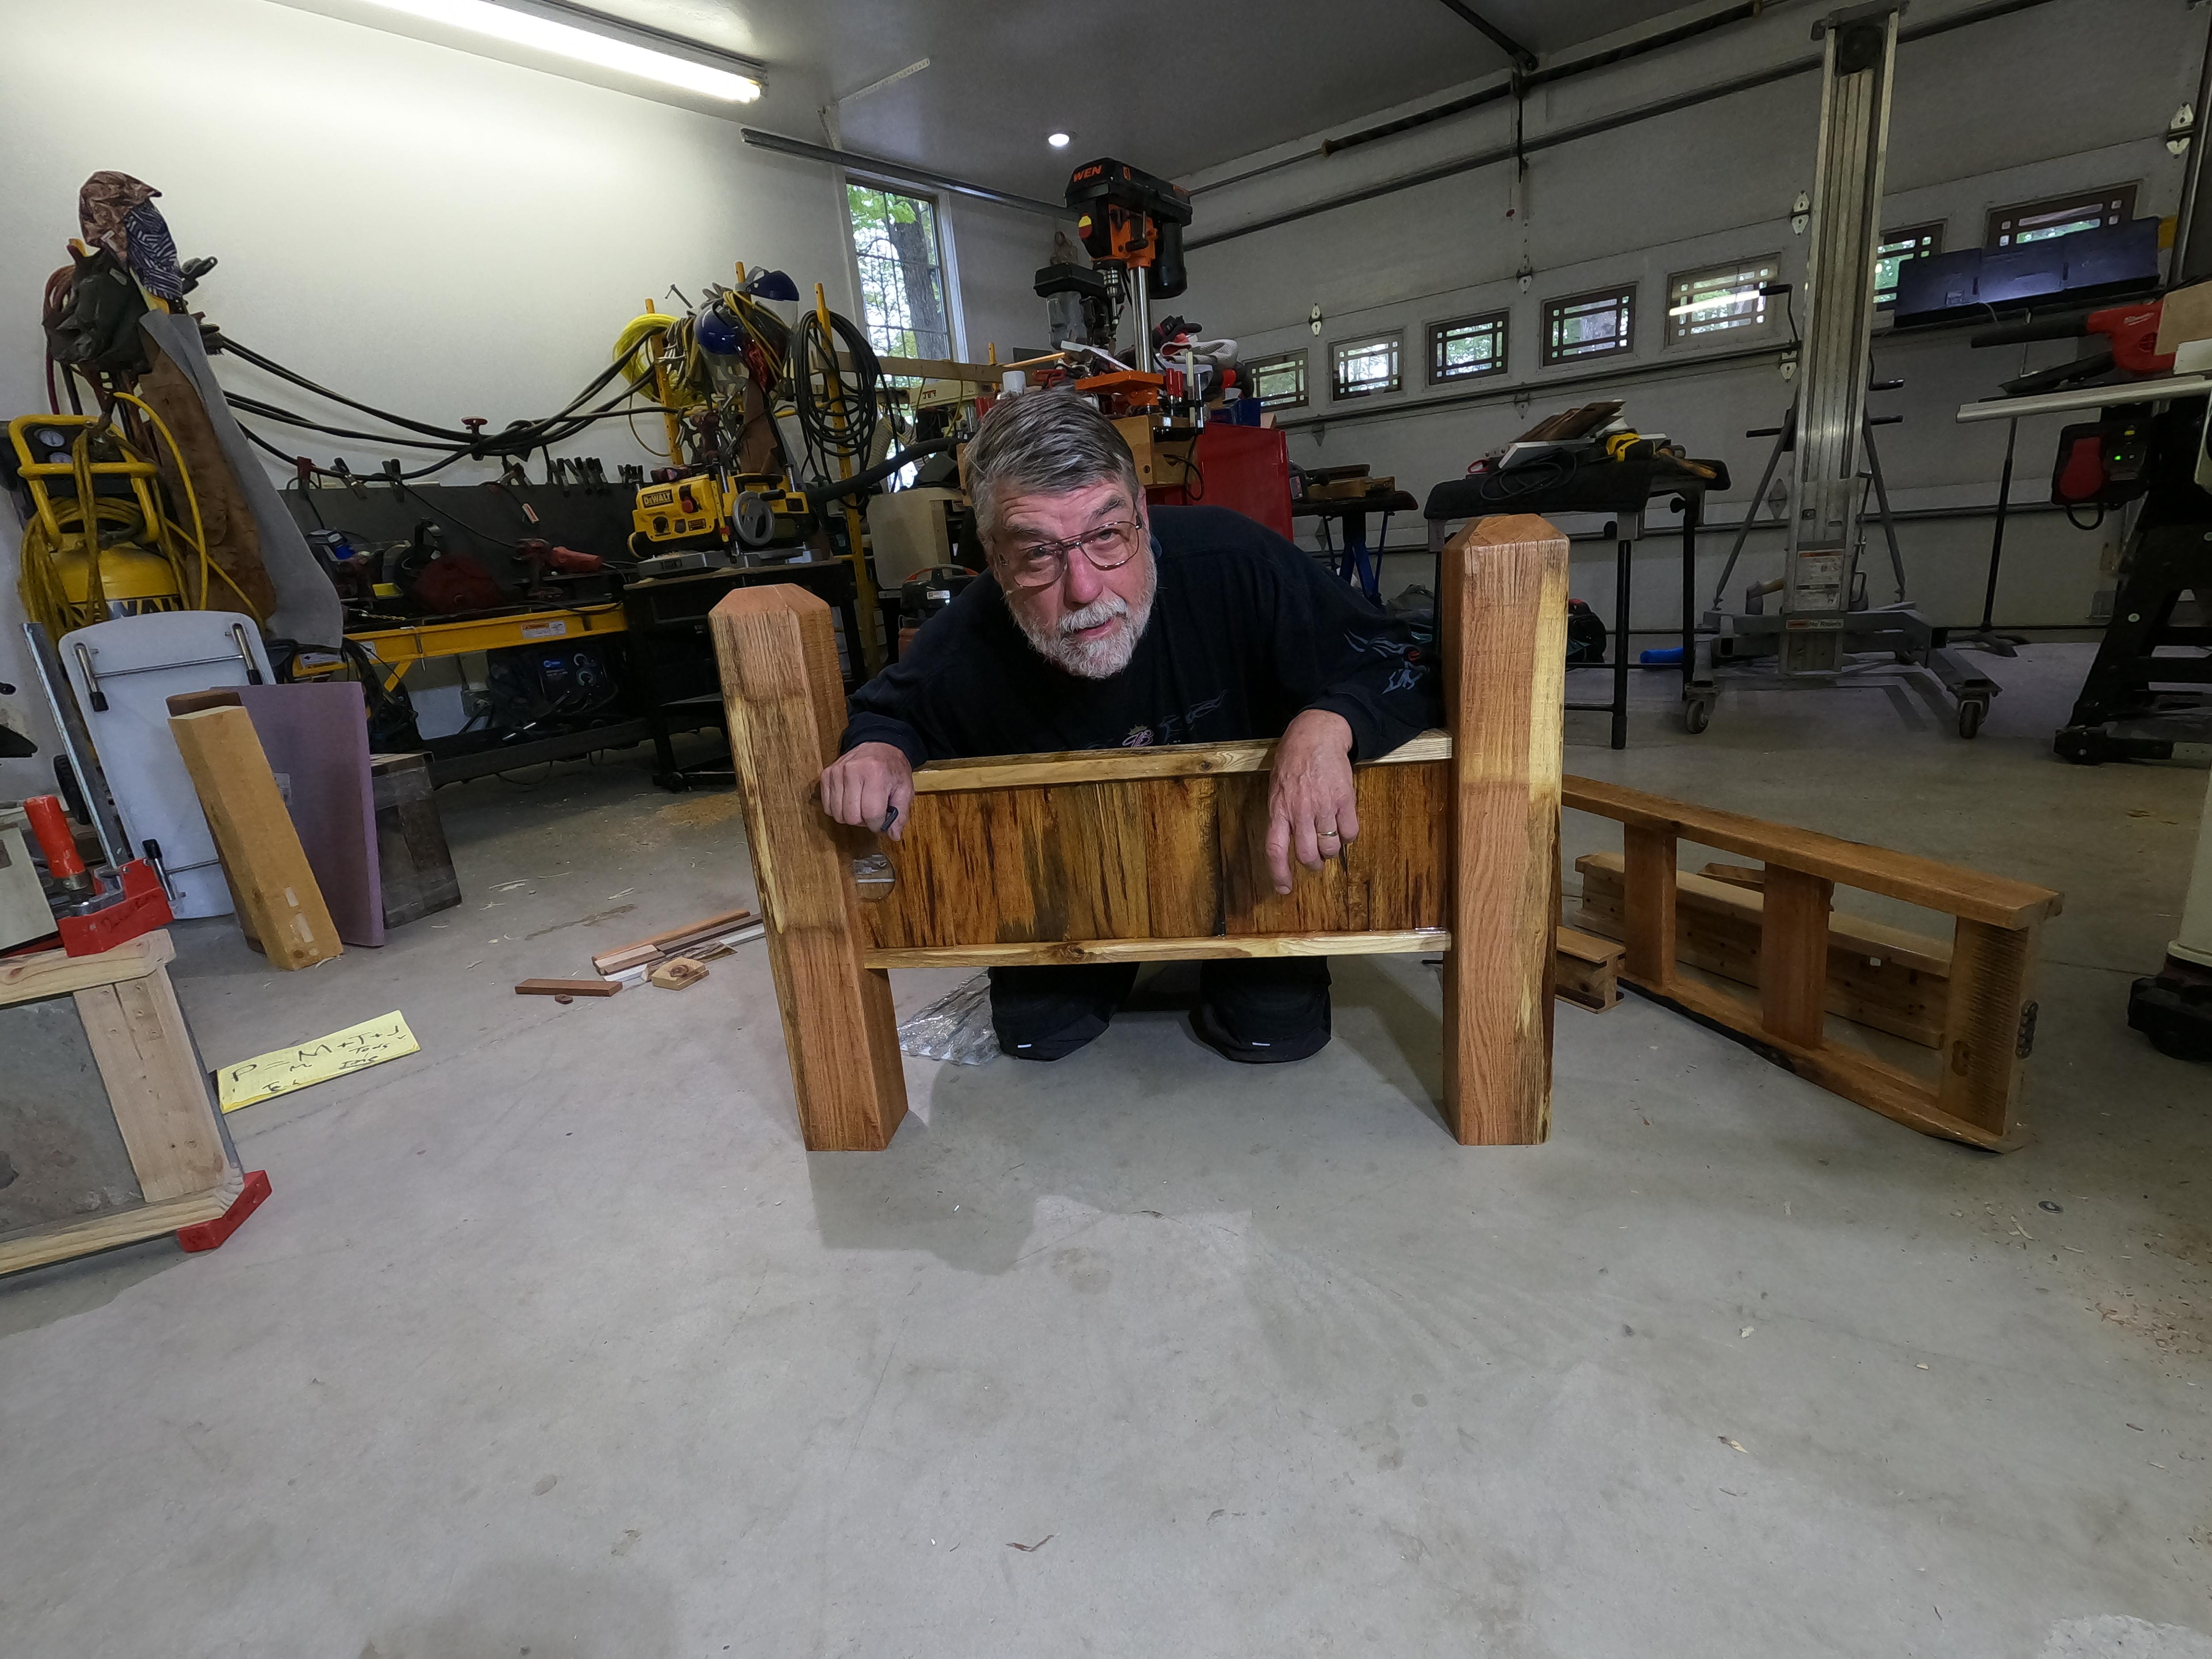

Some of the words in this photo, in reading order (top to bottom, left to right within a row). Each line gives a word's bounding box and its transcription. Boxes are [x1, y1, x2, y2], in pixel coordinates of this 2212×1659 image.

[1073, 164, 1102, 182] WEN
[922, 390, 937, 399] JET
[231, 1064, 257, 1082] P
[298, 1044, 332, 1062] M
